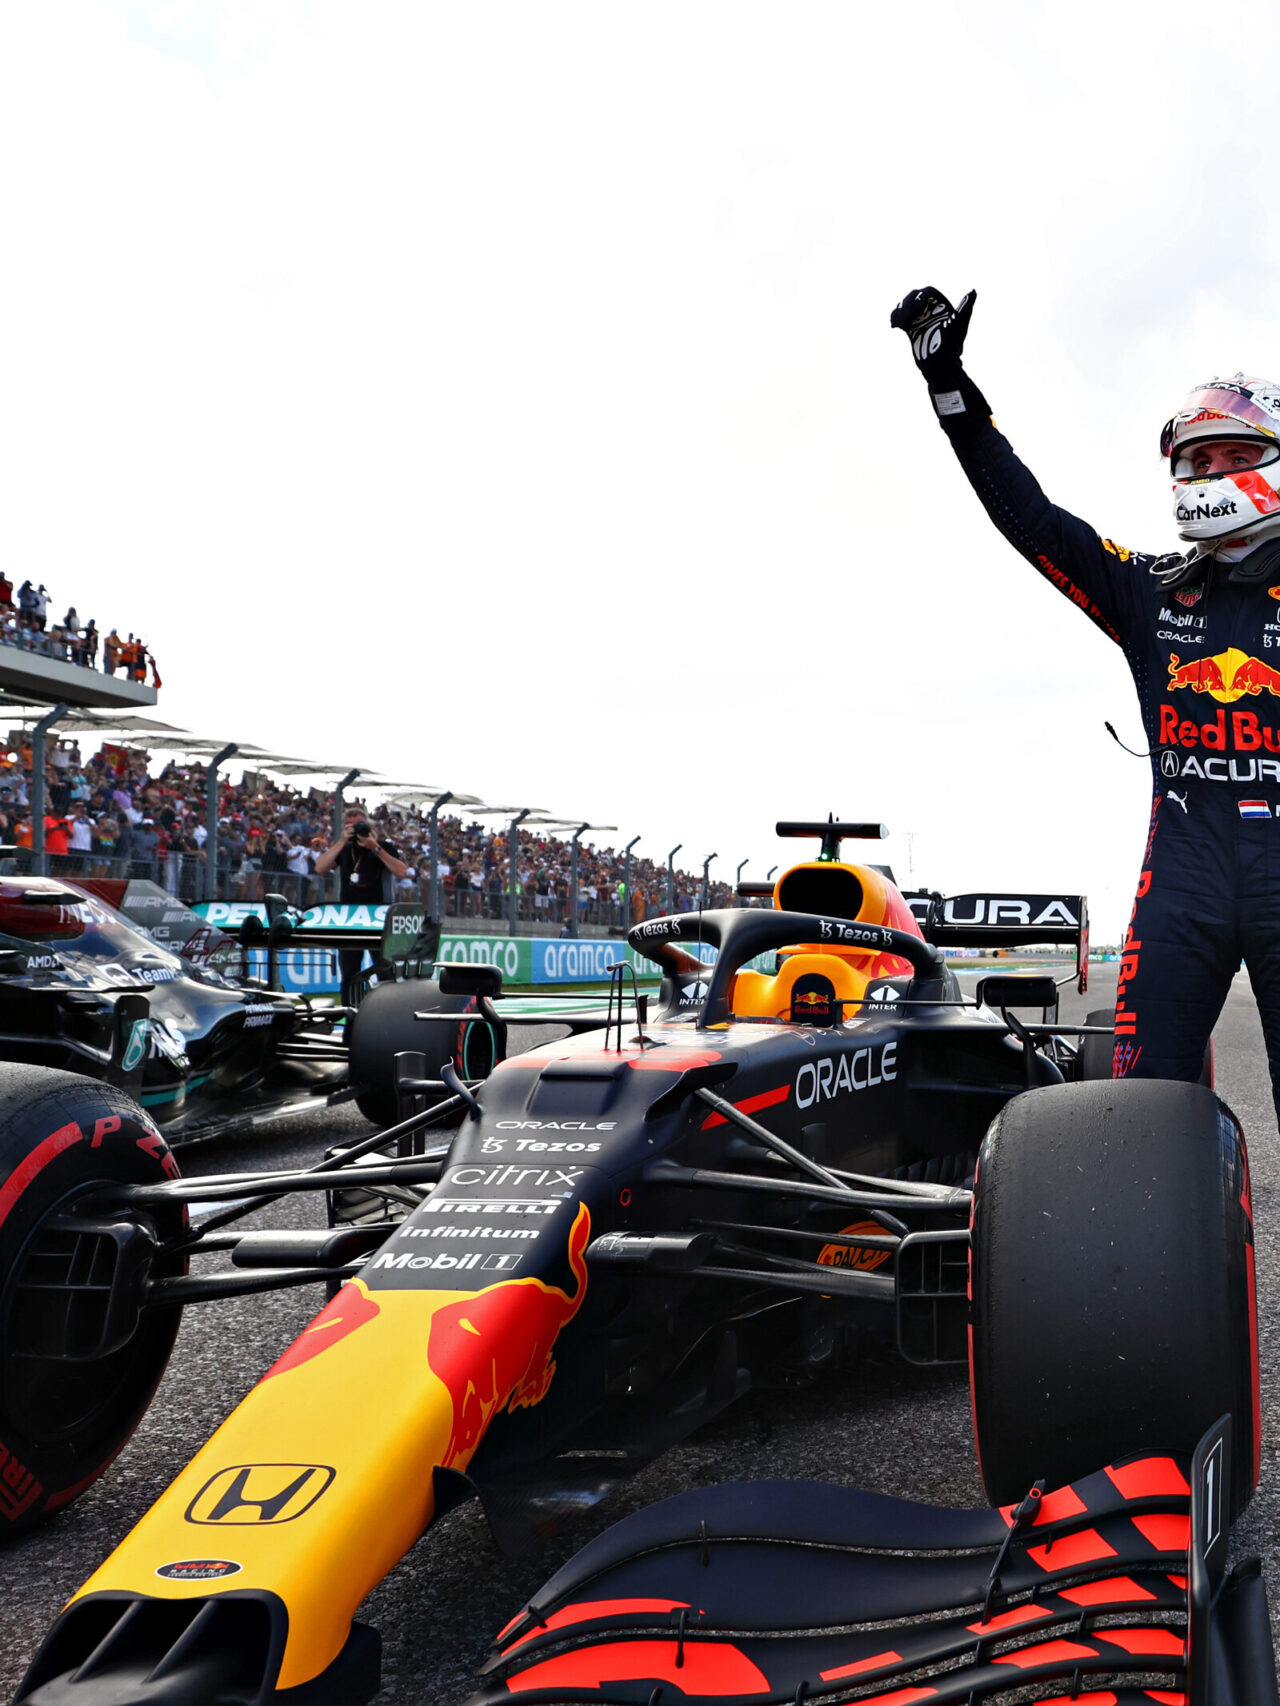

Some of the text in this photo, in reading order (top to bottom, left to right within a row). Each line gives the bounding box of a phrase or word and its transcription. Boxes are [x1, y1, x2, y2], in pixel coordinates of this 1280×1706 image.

[1176, 501, 1238, 522] CarNext
[1157, 607, 1194, 627] Mobil
[1156, 630, 1204, 644] ORACLE
[1158, 703, 1227, 751] Red
[206, 903, 388, 927] PETONAS
[836, 924, 879, 943] Tezos
[544, 944, 615, 978] aramco
[795, 1041, 898, 1110] ORACLE
[495, 1120, 618, 1131] ORACLE
[515, 1139, 602, 1152] Tezos
[422, 1198, 563, 1215] PIRELLI
[399, 1226, 541, 1239] infinitum
[371, 1253, 483, 1270] Mobil
